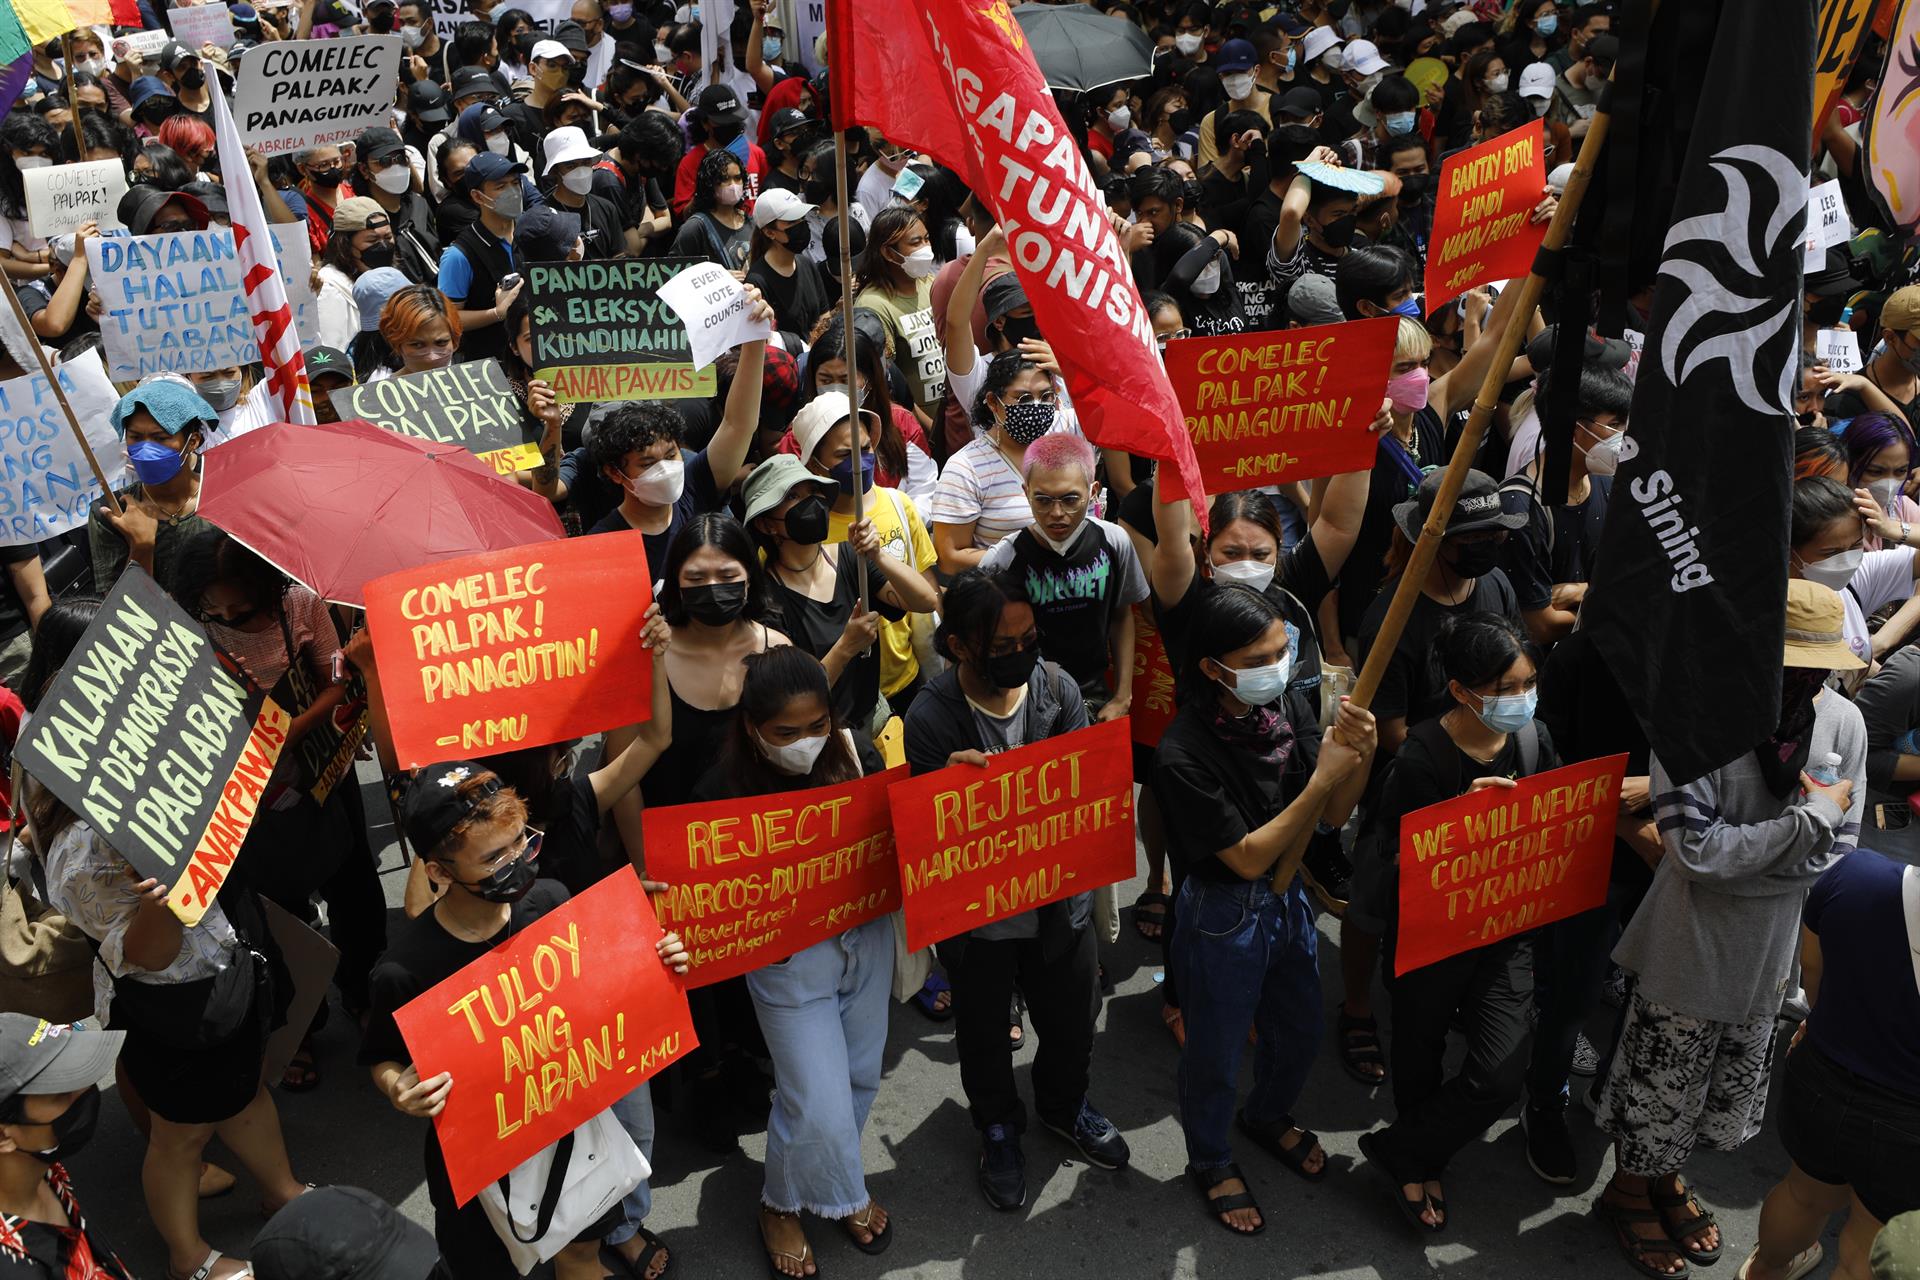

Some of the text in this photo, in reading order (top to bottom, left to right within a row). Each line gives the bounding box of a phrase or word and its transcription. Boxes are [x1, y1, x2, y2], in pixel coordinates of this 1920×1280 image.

[262, 45, 384, 78] COMELEC
[271, 74, 380, 103] PALPAK!
[246, 103, 389, 132] PANAGUTIN!
[47, 167, 107, 192] COMELEC
[1450, 135, 1533, 198] BANTAY BOTO!
[53, 187, 108, 212] PALPAK!
[1460, 187, 1505, 228] HINDI
[1820, 194, 1837, 212] LEC
[101, 231, 235, 273] DAYAAN
[530, 261, 693, 295] PANDARAY
[703, 285, 735, 306] VOTE
[1243, 292, 1266, 305] NG
[109, 294, 249, 335] TUTULA
[567, 297, 684, 326] ELEKSYO
[703, 299, 745, 329] COUNTS!
[1197, 337, 1335, 375] COMELEC
[352, 360, 513, 419] COMELEC
[1196, 366, 1328, 411] PALPAK!
[0, 408, 59, 452] POS
[1184, 397, 1352, 445] PANAGUTIN!
[1222, 452, 1298, 478] -KMU-
[0, 462, 98, 516] BAN-
[1629, 469, 1716, 593] Sining
[401, 562, 548, 621] COMELEC
[411, 599, 545, 661] PALPAK!
[32, 594, 158, 783] KALAYAAN
[420, 628, 599, 704] PANAGUTIN!
[82, 621, 205, 834] AT DEMOKRASYA
[436, 713, 529, 750] -KMU
[127, 664, 248, 867] IPAGLABAN
[181, 710, 285, 909] -ANAKPAWIS-
[933, 750, 1089, 843] REJECT
[1411, 774, 1613, 862] WE WILL NEVER
[686, 796, 852, 870] REJECT
[903, 788, 1133, 897] MARCOS-DUTERTE!
[1430, 814, 1595, 891] CONCEDE TO
[1444, 849, 1576, 921] TYRANNY
[808, 888, 887, 930] -KMU
[447, 921, 583, 1045] TULOY
[504, 1005, 574, 1084] ANG
[625, 1031, 681, 1075] -KMU
[495, 1011, 626, 1140] LABAN!
